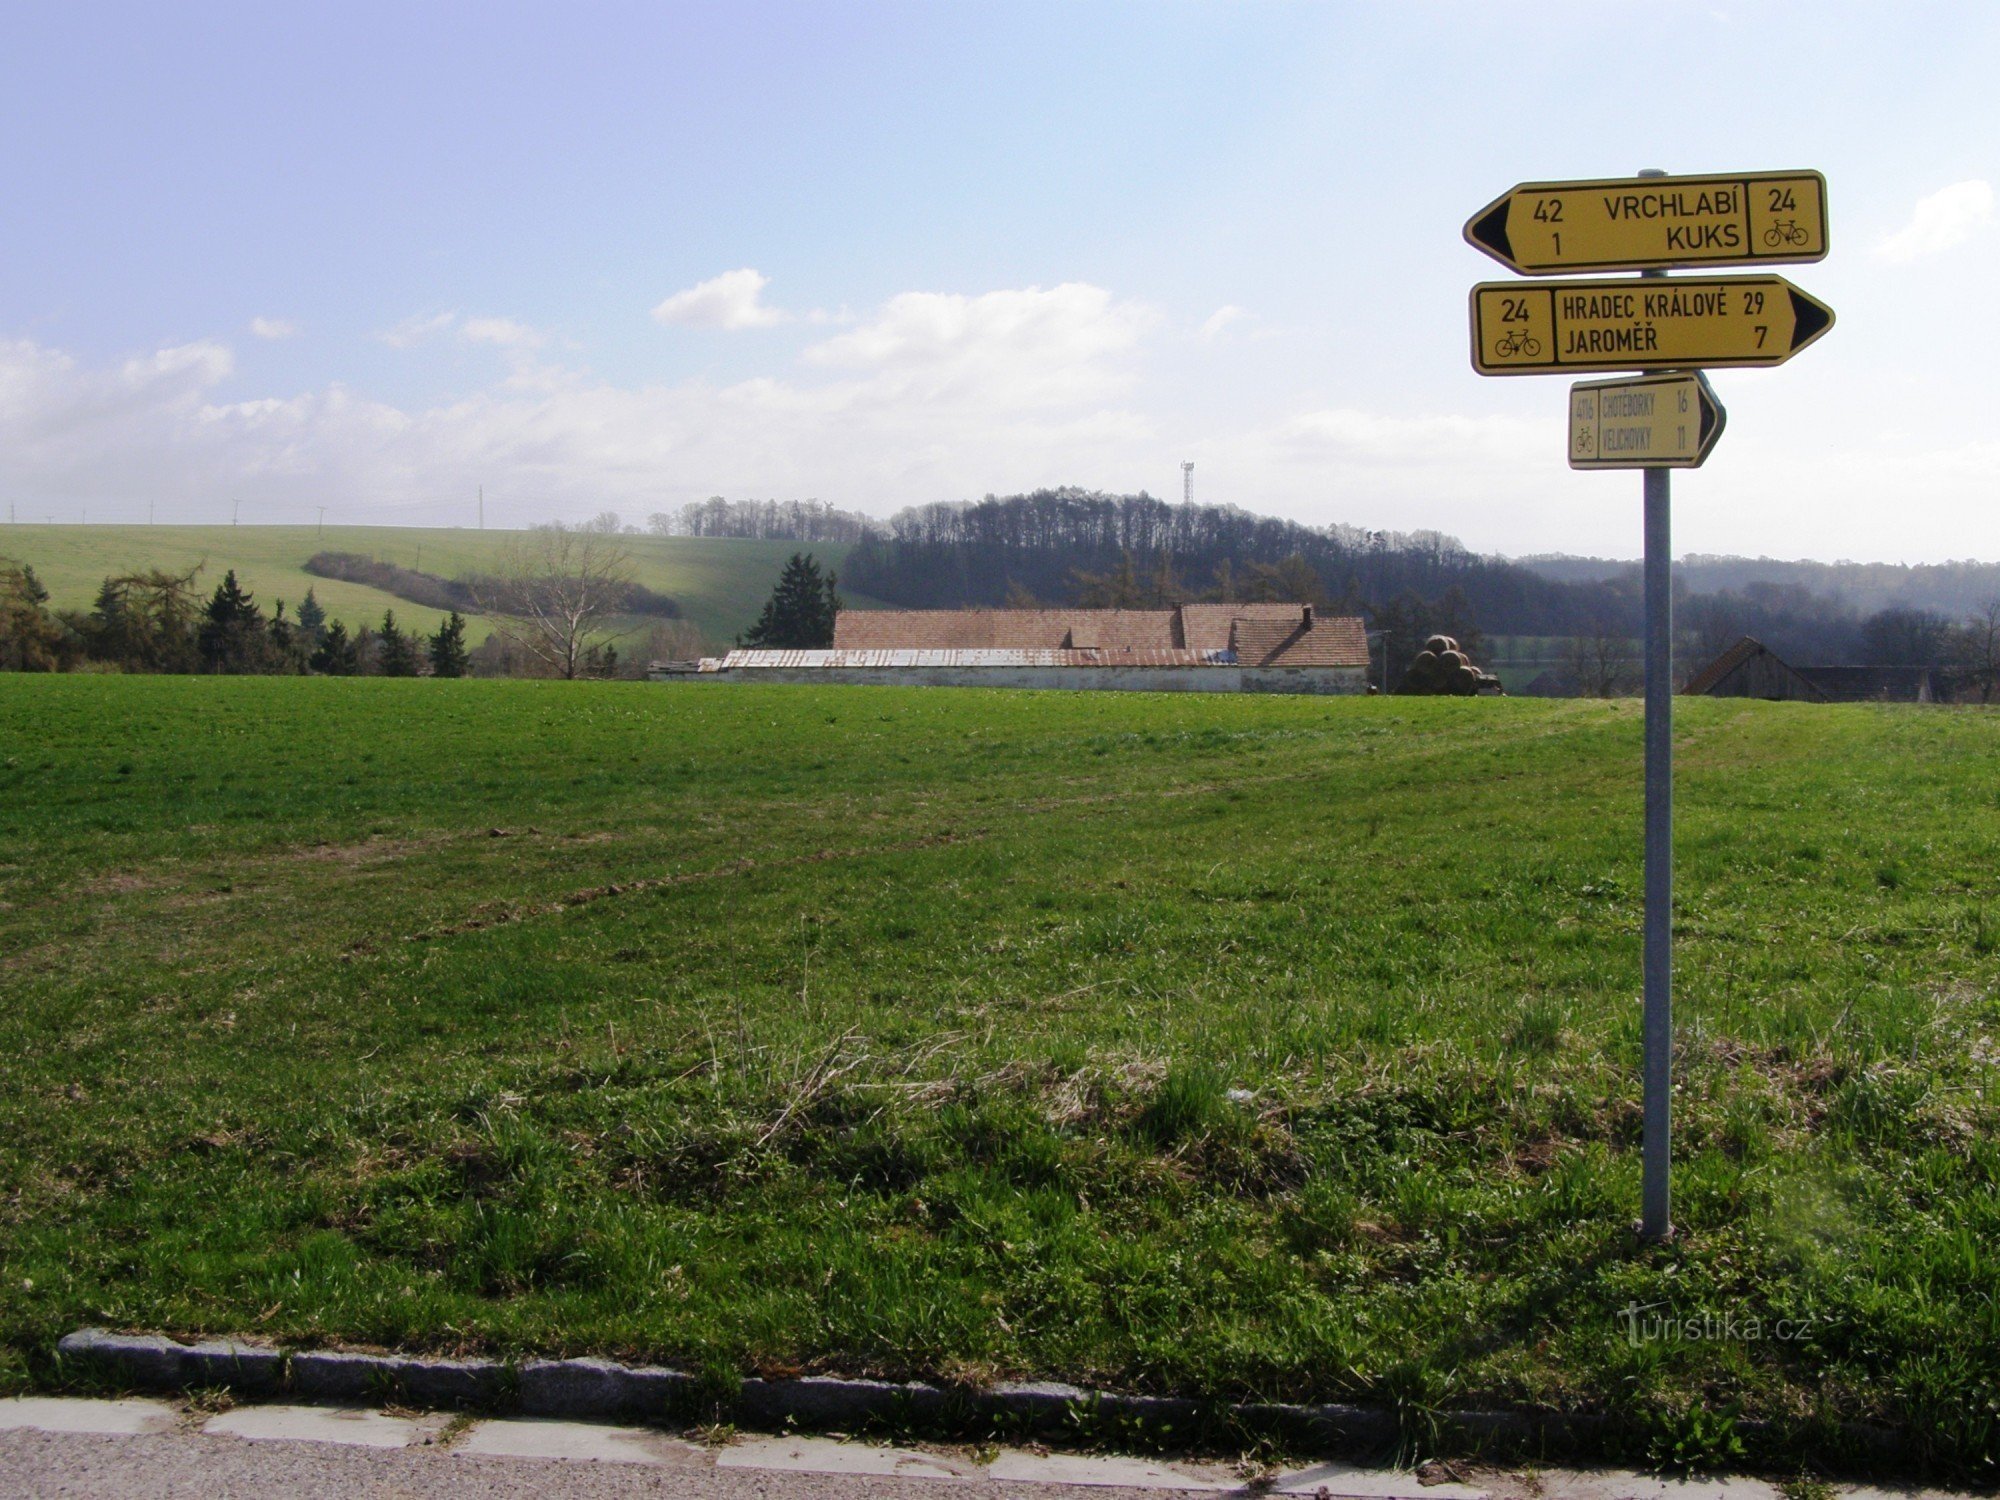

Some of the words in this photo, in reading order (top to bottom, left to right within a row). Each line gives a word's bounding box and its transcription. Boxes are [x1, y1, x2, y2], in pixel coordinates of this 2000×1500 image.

[1533, 199, 1563, 223] 42
[1603, 185, 1738, 220] VRCHLABÍ
[1768, 188, 1796, 212] 24
[1552, 232, 1561, 256] 1
[1666, 223, 1740, 251] KUKS
[1501, 299, 1529, 322] 24
[1563, 293, 1634, 320] HRADEC
[1645, 286, 1728, 318] KRÁLOVÉ
[1743, 292, 1764, 316] 29
[1565, 321, 1658, 354] JAROMĚŘ
[1754, 325, 1768, 349] 7
[1677, 389, 1688, 413] 16
[1603, 427, 1652, 451] VELICHOVKY
[1677, 426, 1686, 450] 11
